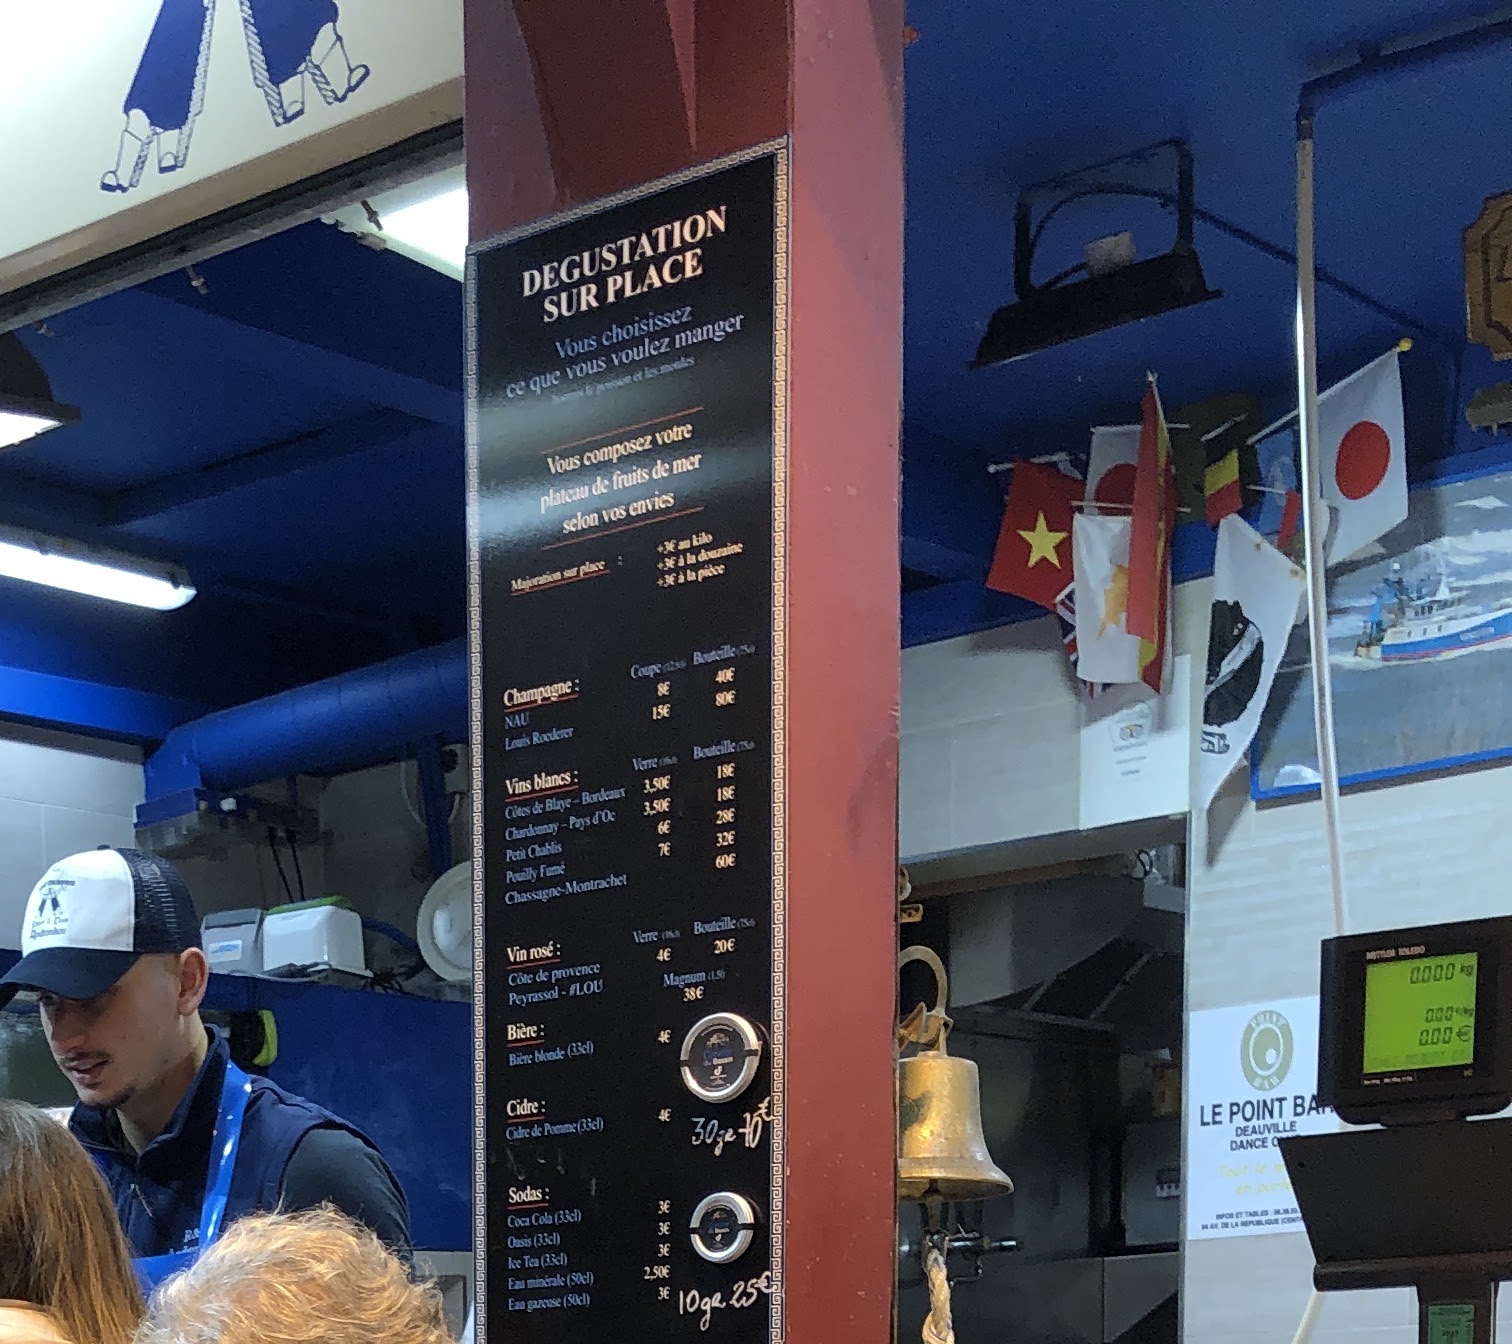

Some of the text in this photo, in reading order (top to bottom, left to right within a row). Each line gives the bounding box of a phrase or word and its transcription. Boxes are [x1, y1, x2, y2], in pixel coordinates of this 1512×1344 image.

[522, 205, 727, 297] DEGUSTATION
[543, 248, 703, 322] SUR PLACE
[555, 306, 692, 358] Vous choisissez
[506, 382, 525, 399] ce
[530, 369, 560, 395] que
[565, 357, 606, 380] vous
[611, 338, 671, 365] voulez
[674, 314, 744, 349] manger
[547, 423, 693, 474] Vous composez votre
[541, 453, 702, 513] plateau de fruits de mer
[563, 491, 674, 534] selon vos envies
[503, 680, 572, 704] Champagne
[505, 778, 531, 794] Vins
[534, 771, 571, 790] blancs
[693, 916, 737, 935] Bouteille
[506, 938, 736, 963] Vin rosé 4€ 20€
[508, 963, 706, 989] Côte de provence Magnum
[508, 985, 560, 1007] Peyrassol
[683, 986, 705, 1002] 38€
[507, 1022, 538, 1041] Bière
[509, 1052, 532, 1067] Bière
[535, 1047, 565, 1063] blonde
[657, 1029, 671, 1044] 4€
[506, 1098, 539, 1117] Cidre
[1200, 1104, 1222, 1126] LE
[1229, 1097, 1287, 1124] POINT
[506, 1125, 530, 1141] Cidre
[657, 1108, 672, 1122] 4€
[1235, 1121, 1297, 1137] DEAUVILLE
[1230, 1137, 1268, 1151] DANCE
[508, 1184, 543, 1203] Sodas
[531, 1211, 553, 1226] Cola
[658, 1200, 671, 1215] 3€
[658, 1222, 671, 1236] 3€
[523, 1255, 540, 1268] Tea
[658, 1243, 671, 1258] 3€
[658, 1286, 671, 1300] 3€
